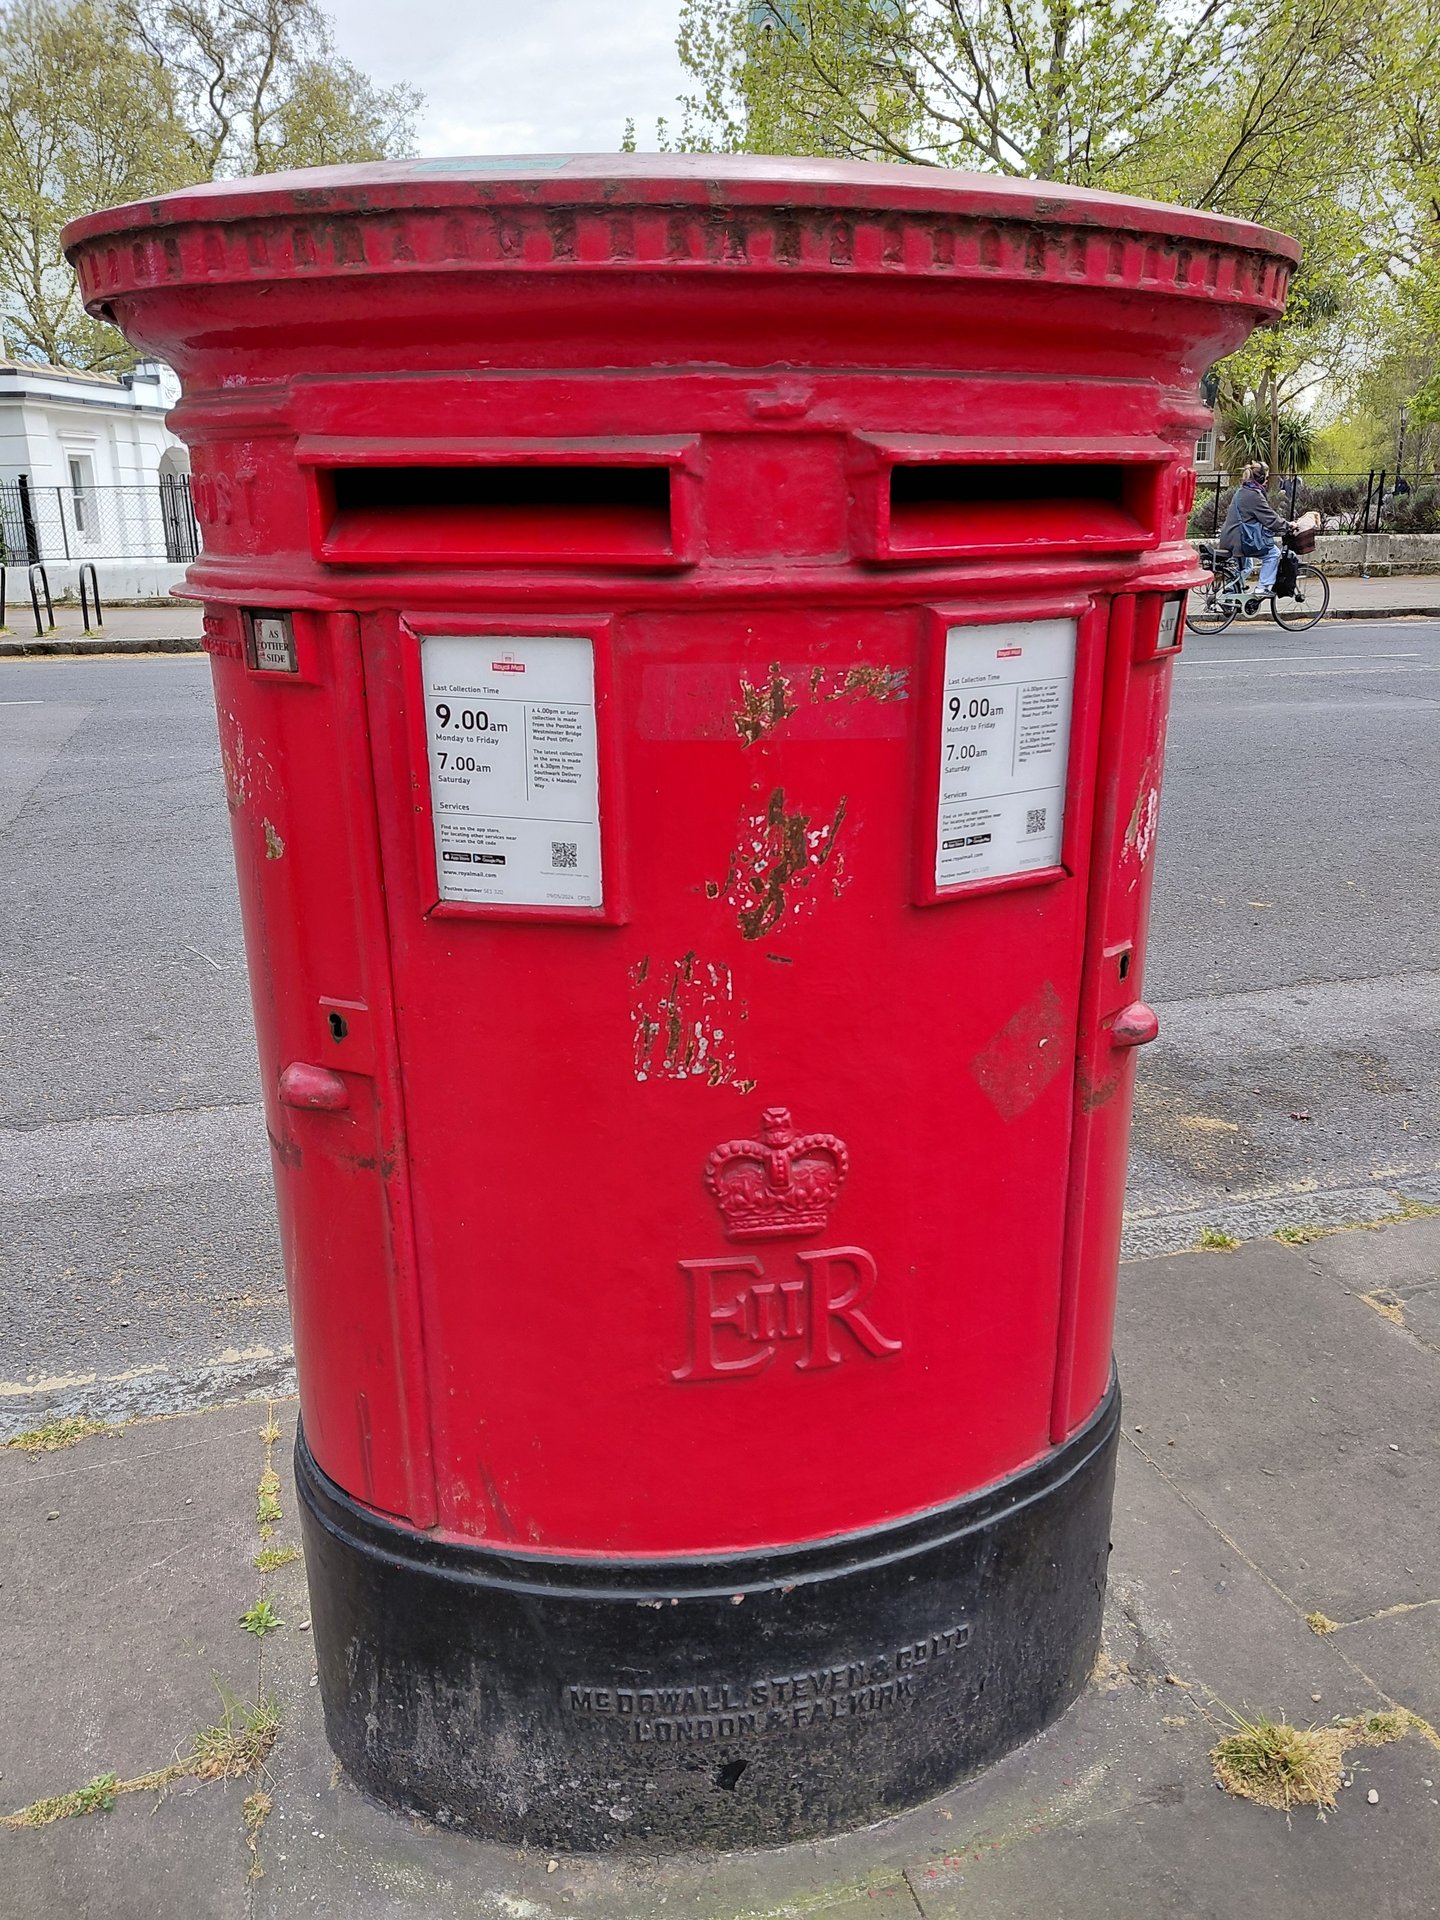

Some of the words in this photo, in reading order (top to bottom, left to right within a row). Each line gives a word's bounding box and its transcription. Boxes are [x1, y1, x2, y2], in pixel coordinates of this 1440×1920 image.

[1160, 619, 1175, 632] SAT
[261, 642, 288, 651] OTHER
[267, 654, 286, 663] SIDE
[493, 663, 510, 671] Royal
[961, 676, 986, 684] Collection
[449, 685, 481, 693] Collection
[949, 697, 1004, 720] 9.00am
[435, 703, 508, 732] 9.00am
[947, 725, 969, 733] Monday
[436, 734, 465, 743] Monday
[477, 737, 499, 745] Friday
[946, 744, 987, 761] 7.00am
[437, 753, 491, 772] 7.00am
[945, 765, 970, 774] Saturday
[438, 775, 470, 785] Saturday
[944, 791, 967, 799] Services
[440, 802, 470, 810] Services
[942, 853, 983, 862] www.royalmail.com
[751, 1660, 865, 1706] STEVEN
[634, 1714, 757, 1742] LONDON
[768, 1710, 787, 1729] &
[794, 1675, 914, 1728] FALKIRK
